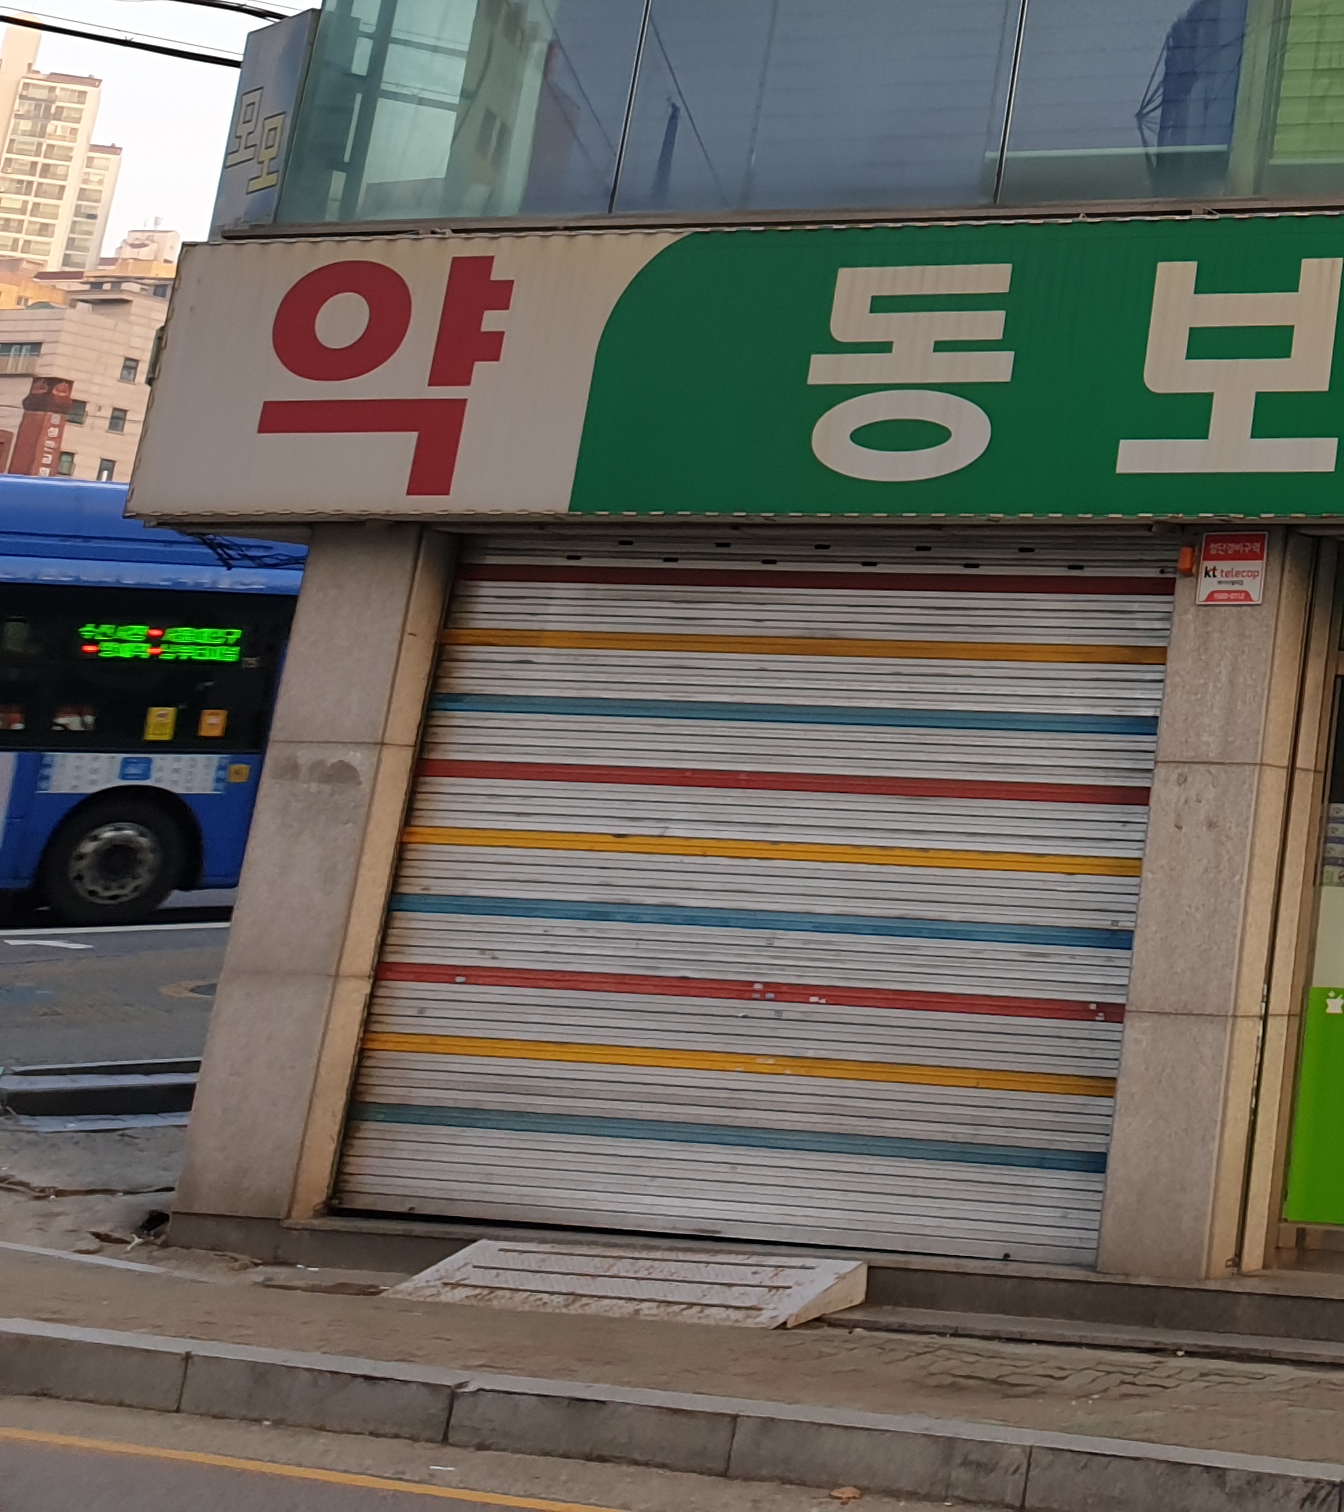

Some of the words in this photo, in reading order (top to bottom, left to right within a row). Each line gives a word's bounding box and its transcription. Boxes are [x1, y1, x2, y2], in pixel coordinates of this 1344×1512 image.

[256, 255, 516, 497] 약
[1204, 566, 1217, 578] kt
[1221, 568, 1260, 580] telecop
